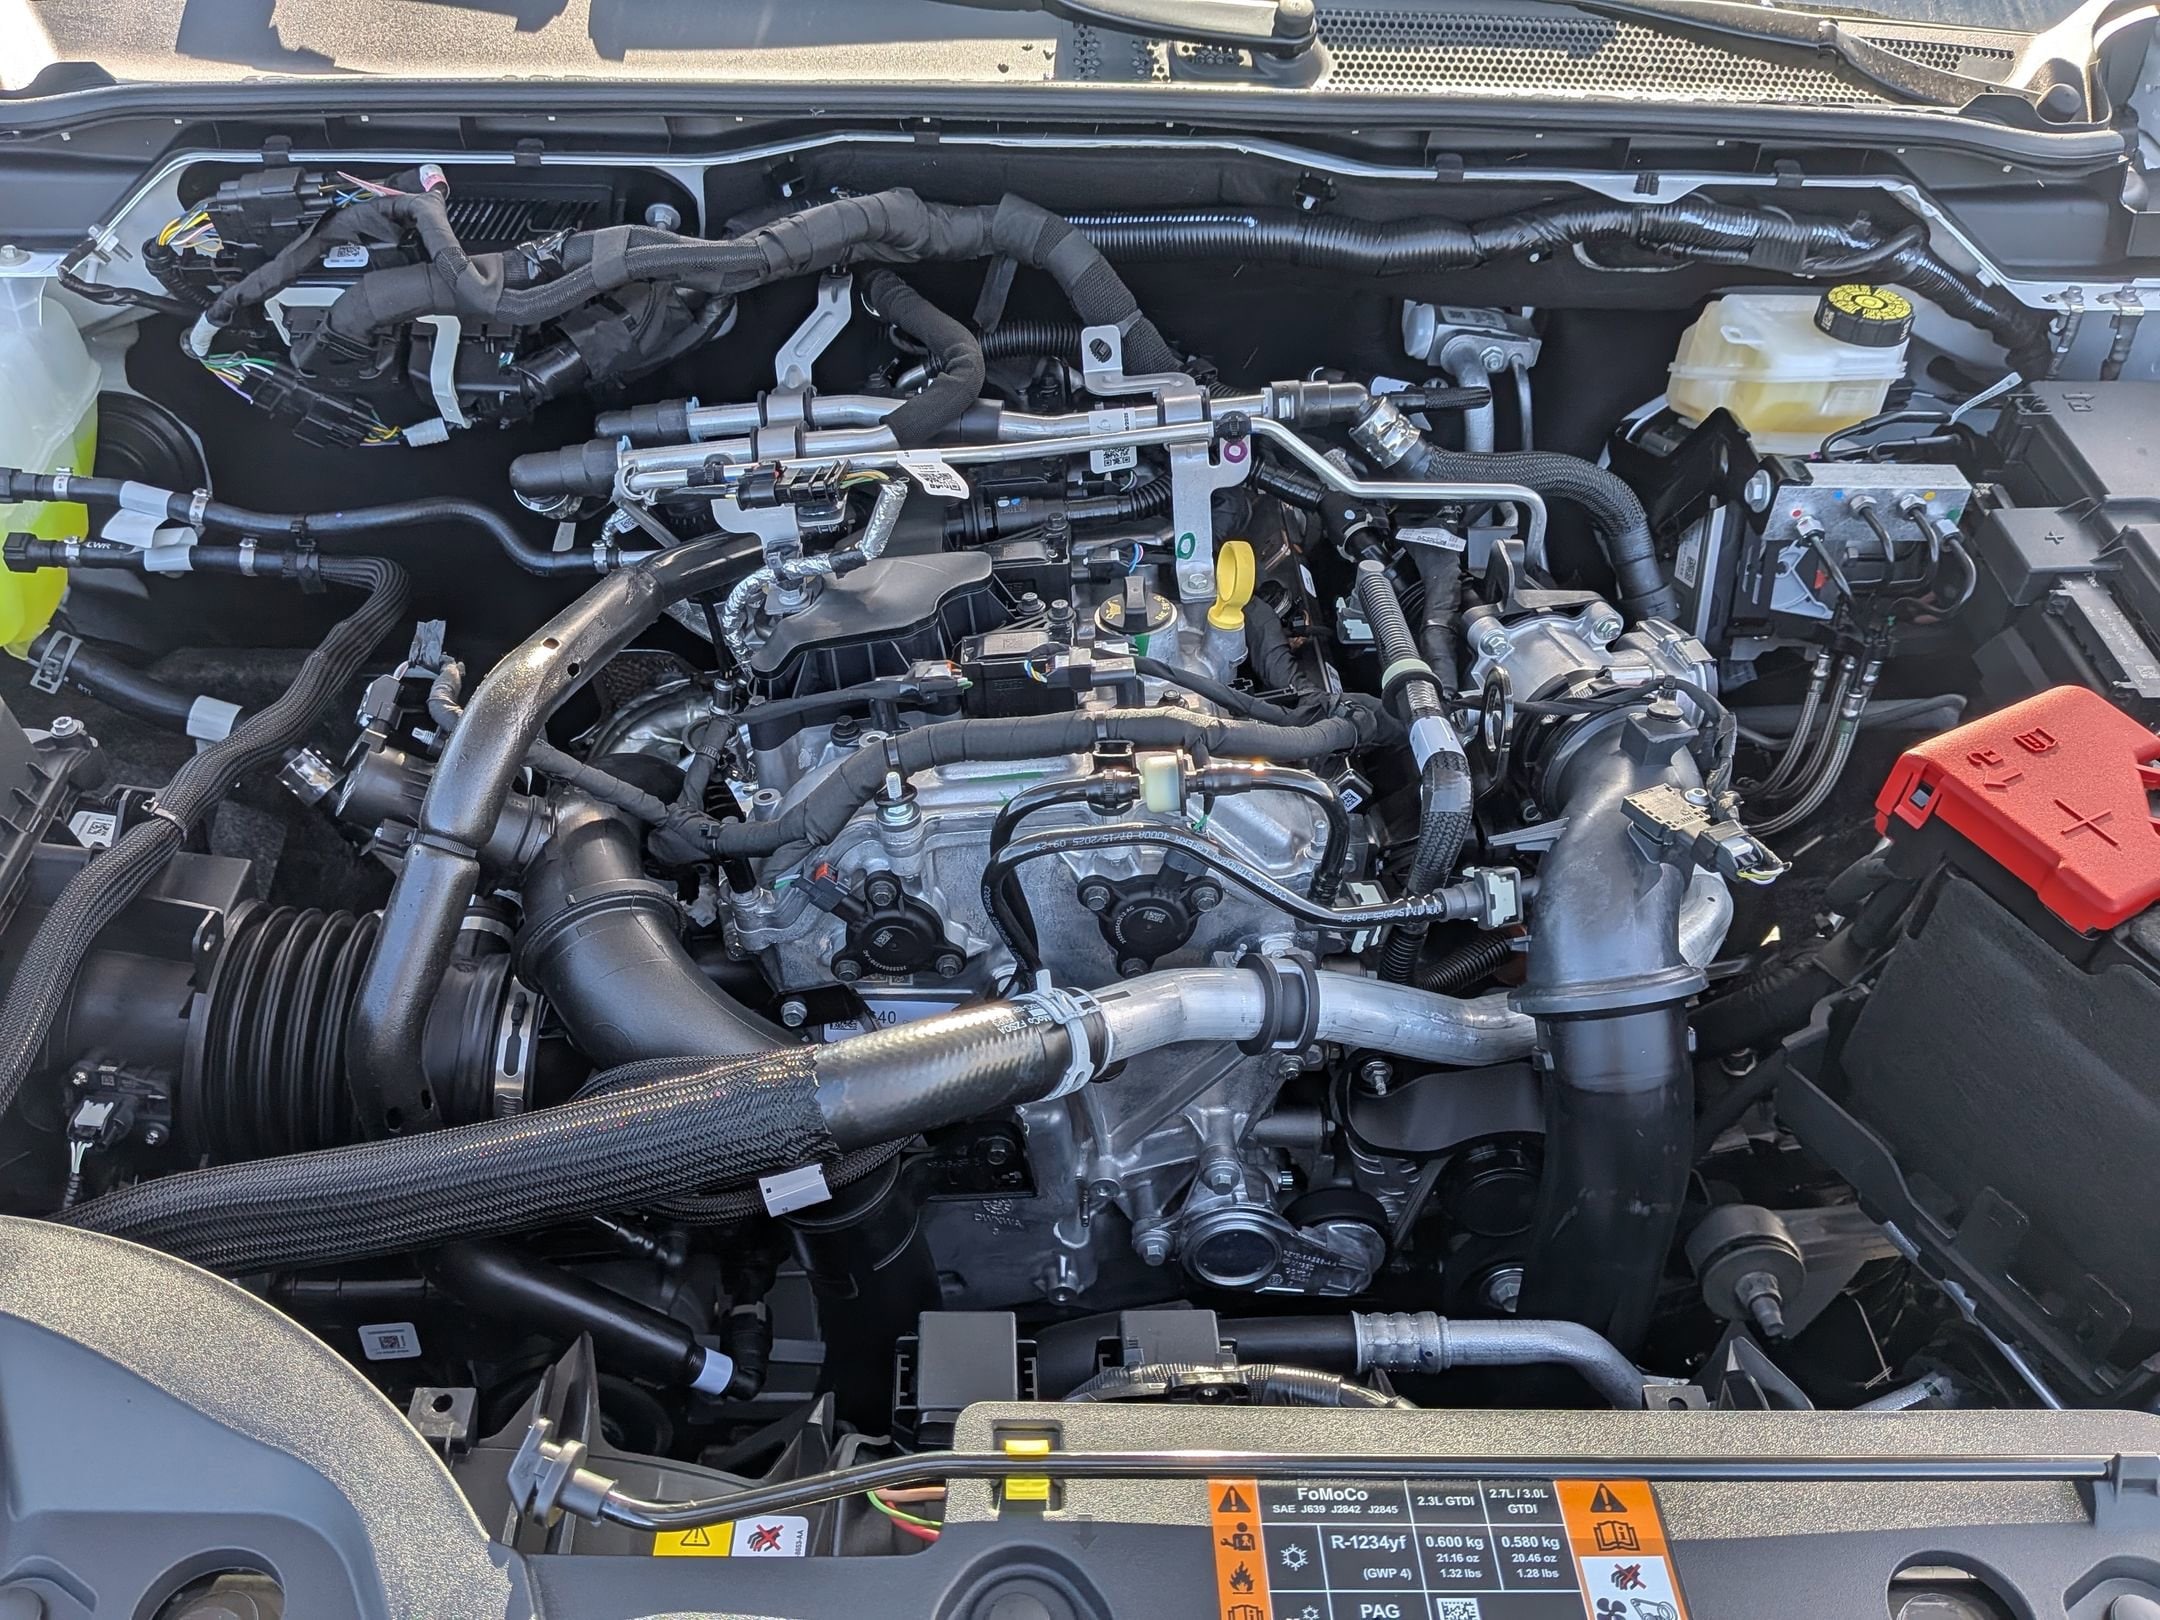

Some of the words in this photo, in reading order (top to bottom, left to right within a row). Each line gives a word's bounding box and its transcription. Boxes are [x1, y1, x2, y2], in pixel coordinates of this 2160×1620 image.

[1257, 877, 1288, 901] COOPER
[1297, 1487, 1369, 1501] FoMoCo
[1489, 1489, 1515, 1499] 2.7L
[1522, 1489, 1549, 1499] 3.0L
[1417, 1496, 1443, 1506] 2.3L
[1445, 1496, 1476, 1506] GTDI
[1272, 1504, 1297, 1514] SAE
[1301, 1504, 1326, 1514] J639
[1331, 1504, 1361, 1514] J2842
[1367, 1505, 1399, 1514] J2845
[1507, 1504, 1538, 1514] GTDI
[1330, 1534, 1407, 1553] R-1234yf
[1425, 1536, 1463, 1548] 0.600
[1466, 1536, 1485, 1550] kg
[1501, 1536, 1539, 1548] 0.580
[1541, 1536, 1560, 1550] kg
[1436, 1553, 1464, 1563] 21.16
[1466, 1555, 1480, 1563] oz
[1511, 1553, 1542, 1563] 20.46
[1544, 1555, 1558, 1563] oz
[1363, 1567, 1397, 1581] (GWP
[1399, 1567, 1413, 1581] 4)
[1440, 1568, 1463, 1578] 1.32
[1465, 1568, 1483, 1578] lbs
[1516, 1568, 1540, 1578] 1.28
[1541, 1568, 1560, 1578] lbs
[1360, 1604, 1401, 1620] PAG
